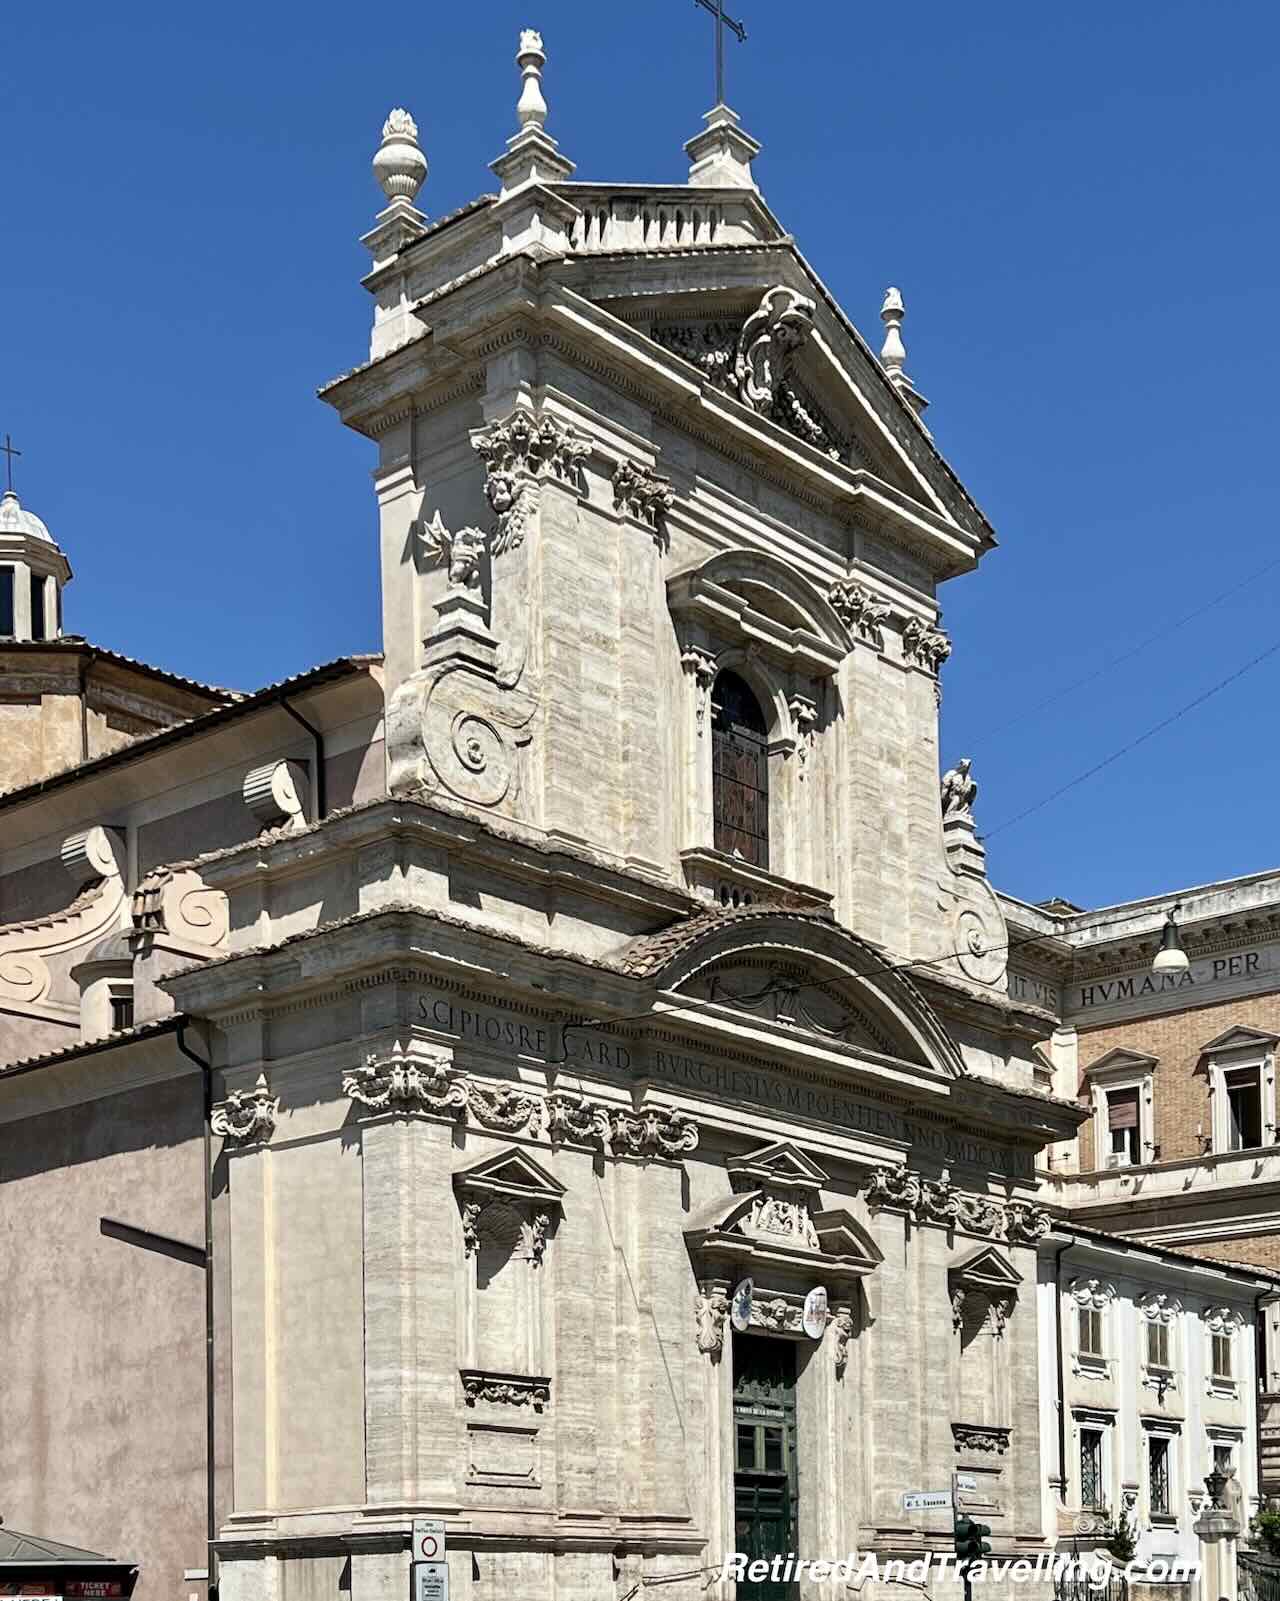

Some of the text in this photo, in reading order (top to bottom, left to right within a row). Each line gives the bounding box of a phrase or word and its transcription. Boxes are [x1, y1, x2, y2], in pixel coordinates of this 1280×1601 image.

[1081, 952, 1260, 1006] HVMANA PER
[80, 1581, 111, 1590] TICKET
